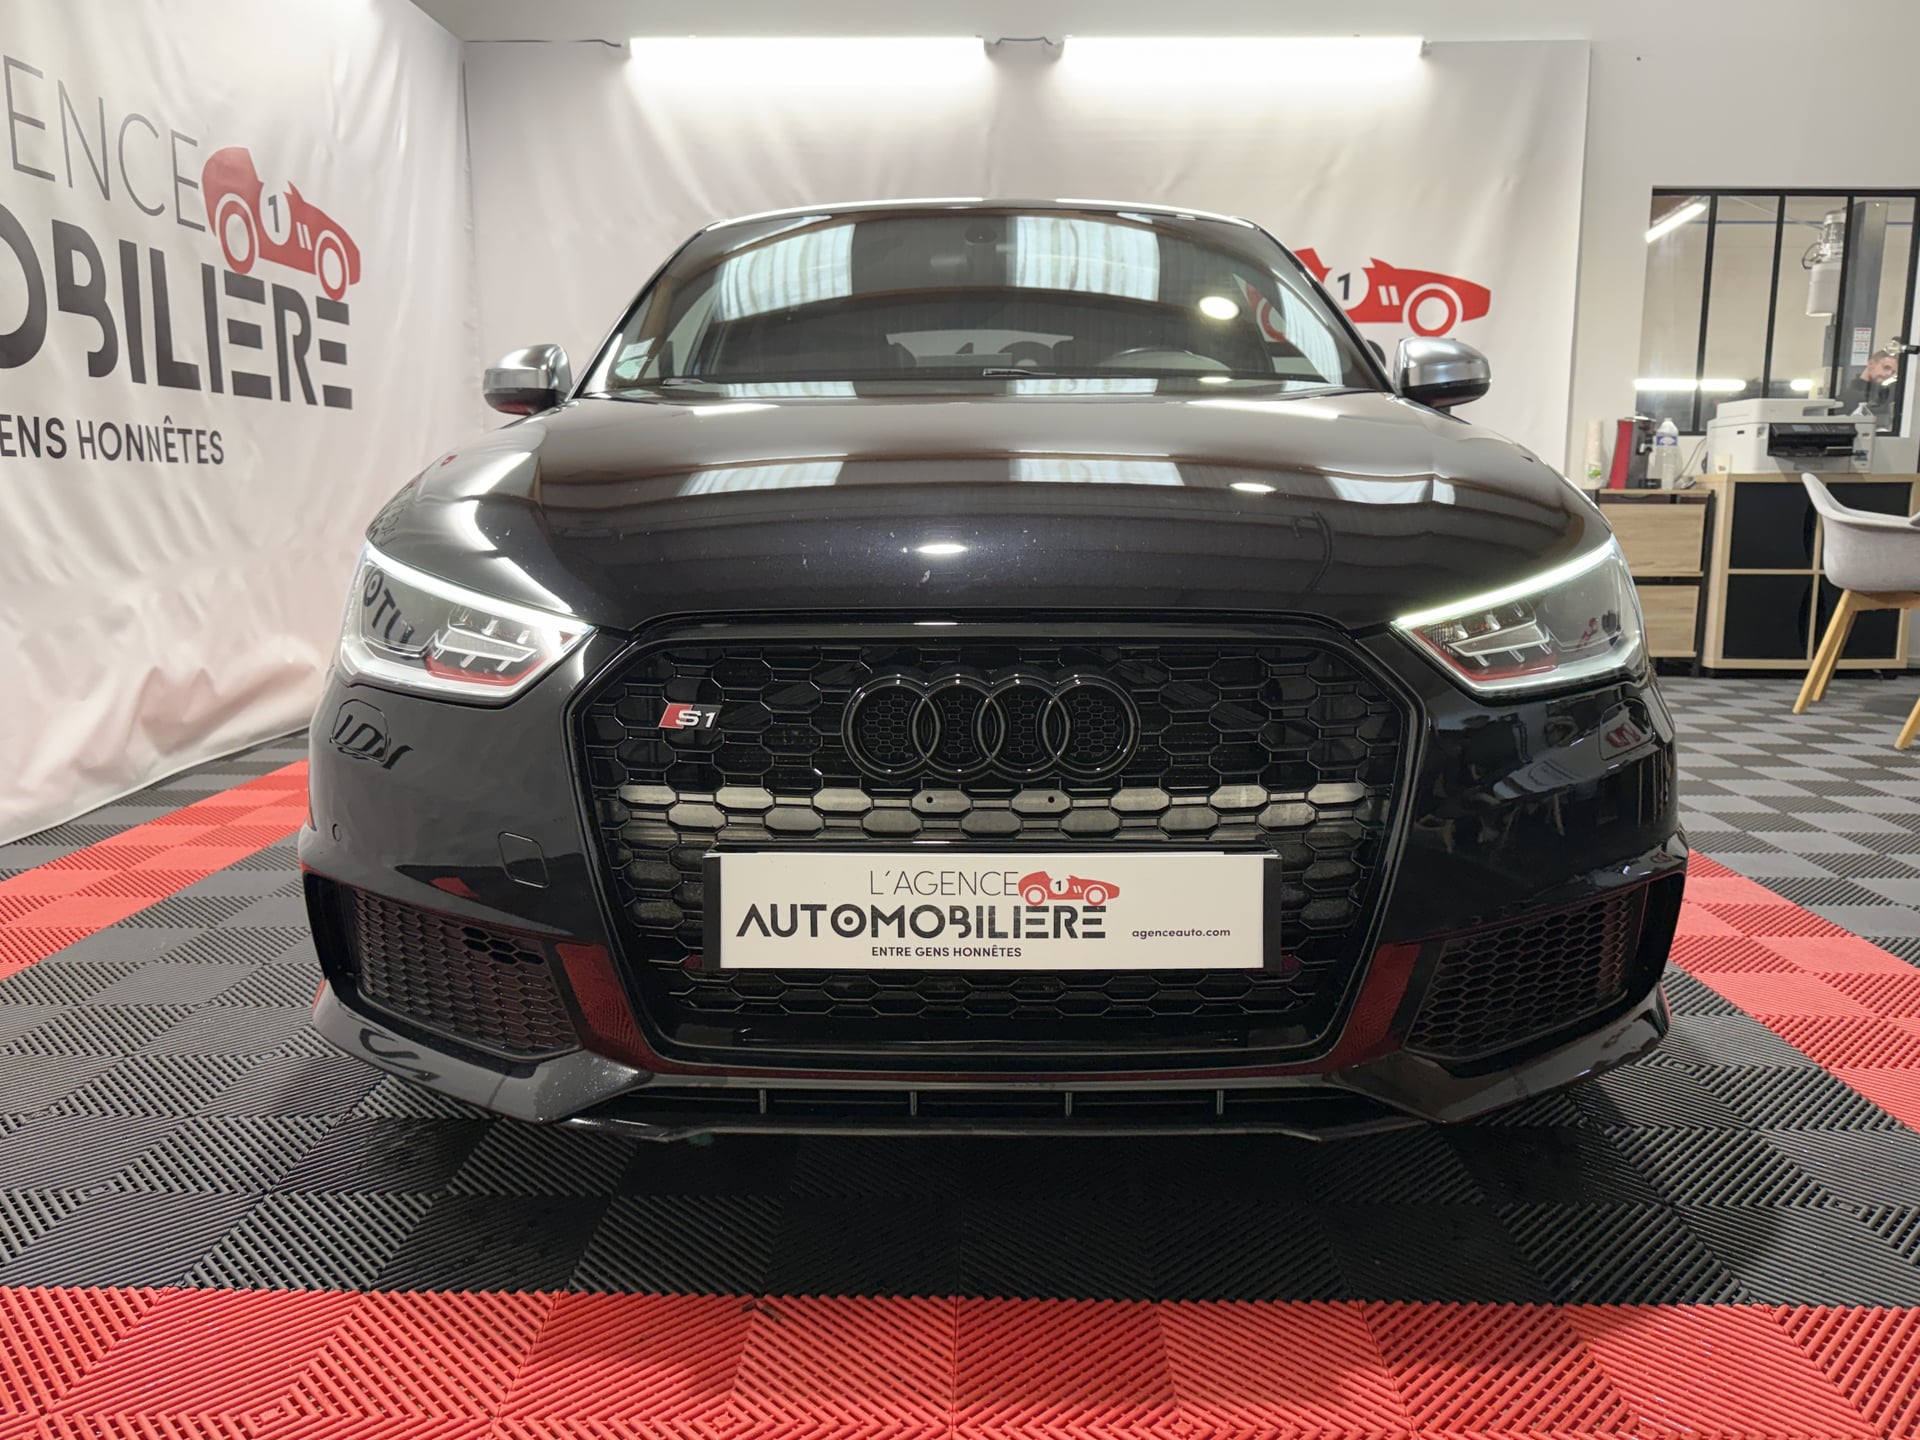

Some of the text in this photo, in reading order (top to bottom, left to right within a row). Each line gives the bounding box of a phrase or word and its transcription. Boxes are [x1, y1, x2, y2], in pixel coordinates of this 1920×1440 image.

[267, 194, 281, 233] 1
[1337, 272, 1351, 301] 1
[76, 415, 225, 465] HONNÊTES
[675, 709, 717, 729] S1
[870, 870, 1019, 897] L'AGENCE
[1055, 880, 1062, 891] 1
[1131, 927, 1231, 940] agenceauto.com
[871, 944, 1022, 957] ENTRE GENS HONNÊTES
